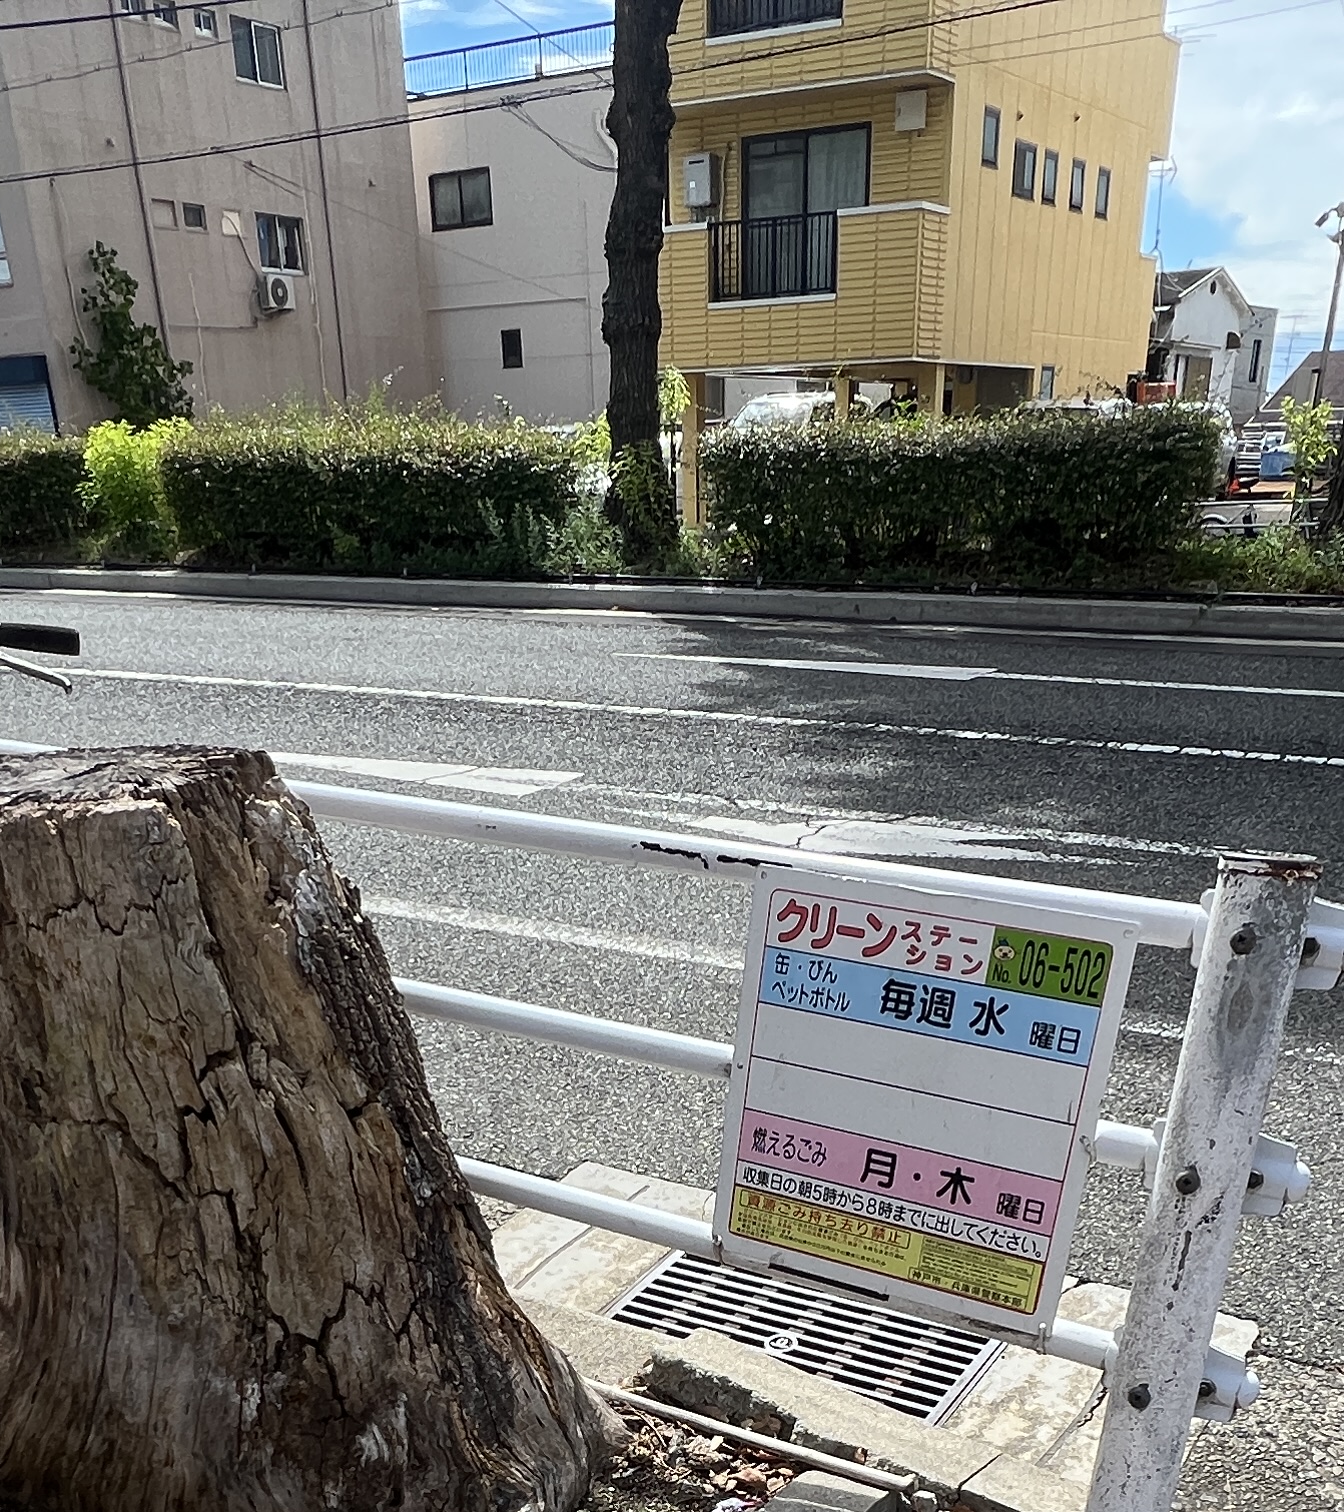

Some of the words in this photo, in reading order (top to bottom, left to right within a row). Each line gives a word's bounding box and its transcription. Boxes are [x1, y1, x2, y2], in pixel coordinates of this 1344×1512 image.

[776, 898, 898, 958] クリーン
[774, 951, 838, 984] 缶・びん
[991, 963, 1012, 984] No.
[1018, 939, 1106, 999] 06-502
[771, 980, 851, 1013] ペットボトル
[1029, 1021, 1082, 1055] 曜日
[750, 1125, 828, 1168] 燃えるごみ
[995, 1192, 1046, 1225] 曜日
